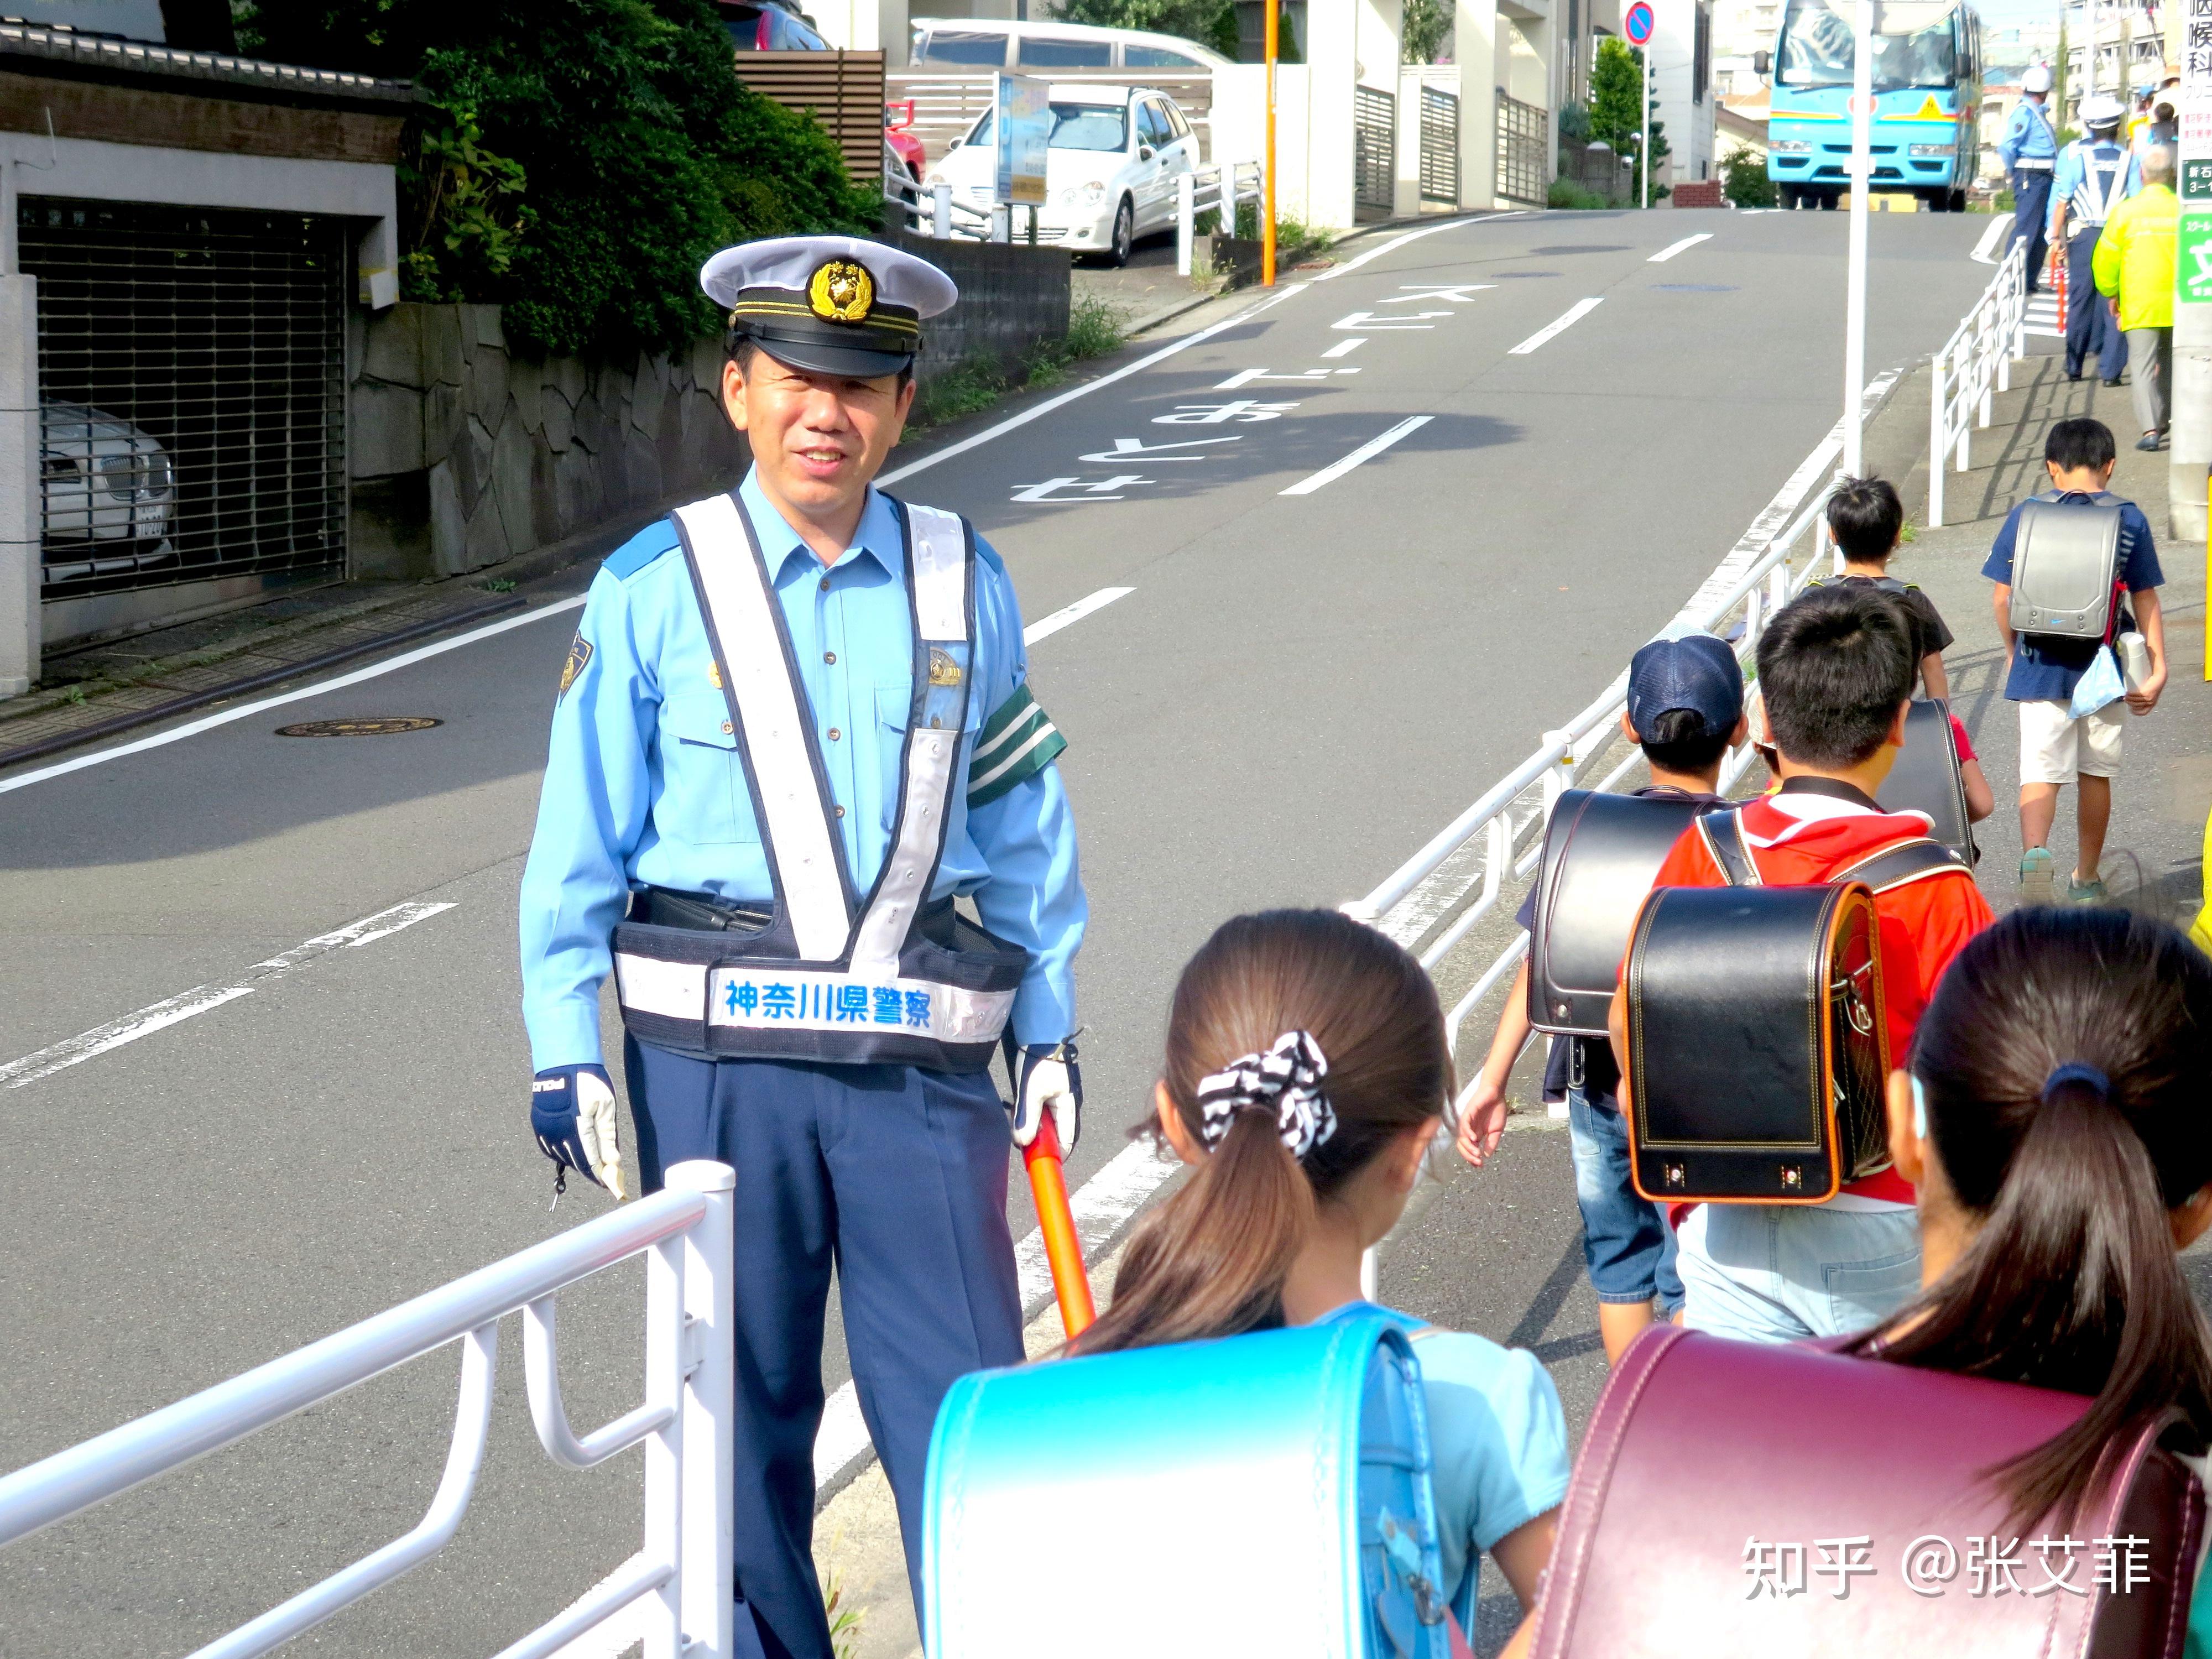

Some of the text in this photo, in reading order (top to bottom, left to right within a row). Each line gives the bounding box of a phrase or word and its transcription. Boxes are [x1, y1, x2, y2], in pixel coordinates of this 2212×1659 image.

[725, 980, 931, 1029] 神奈川県警察
